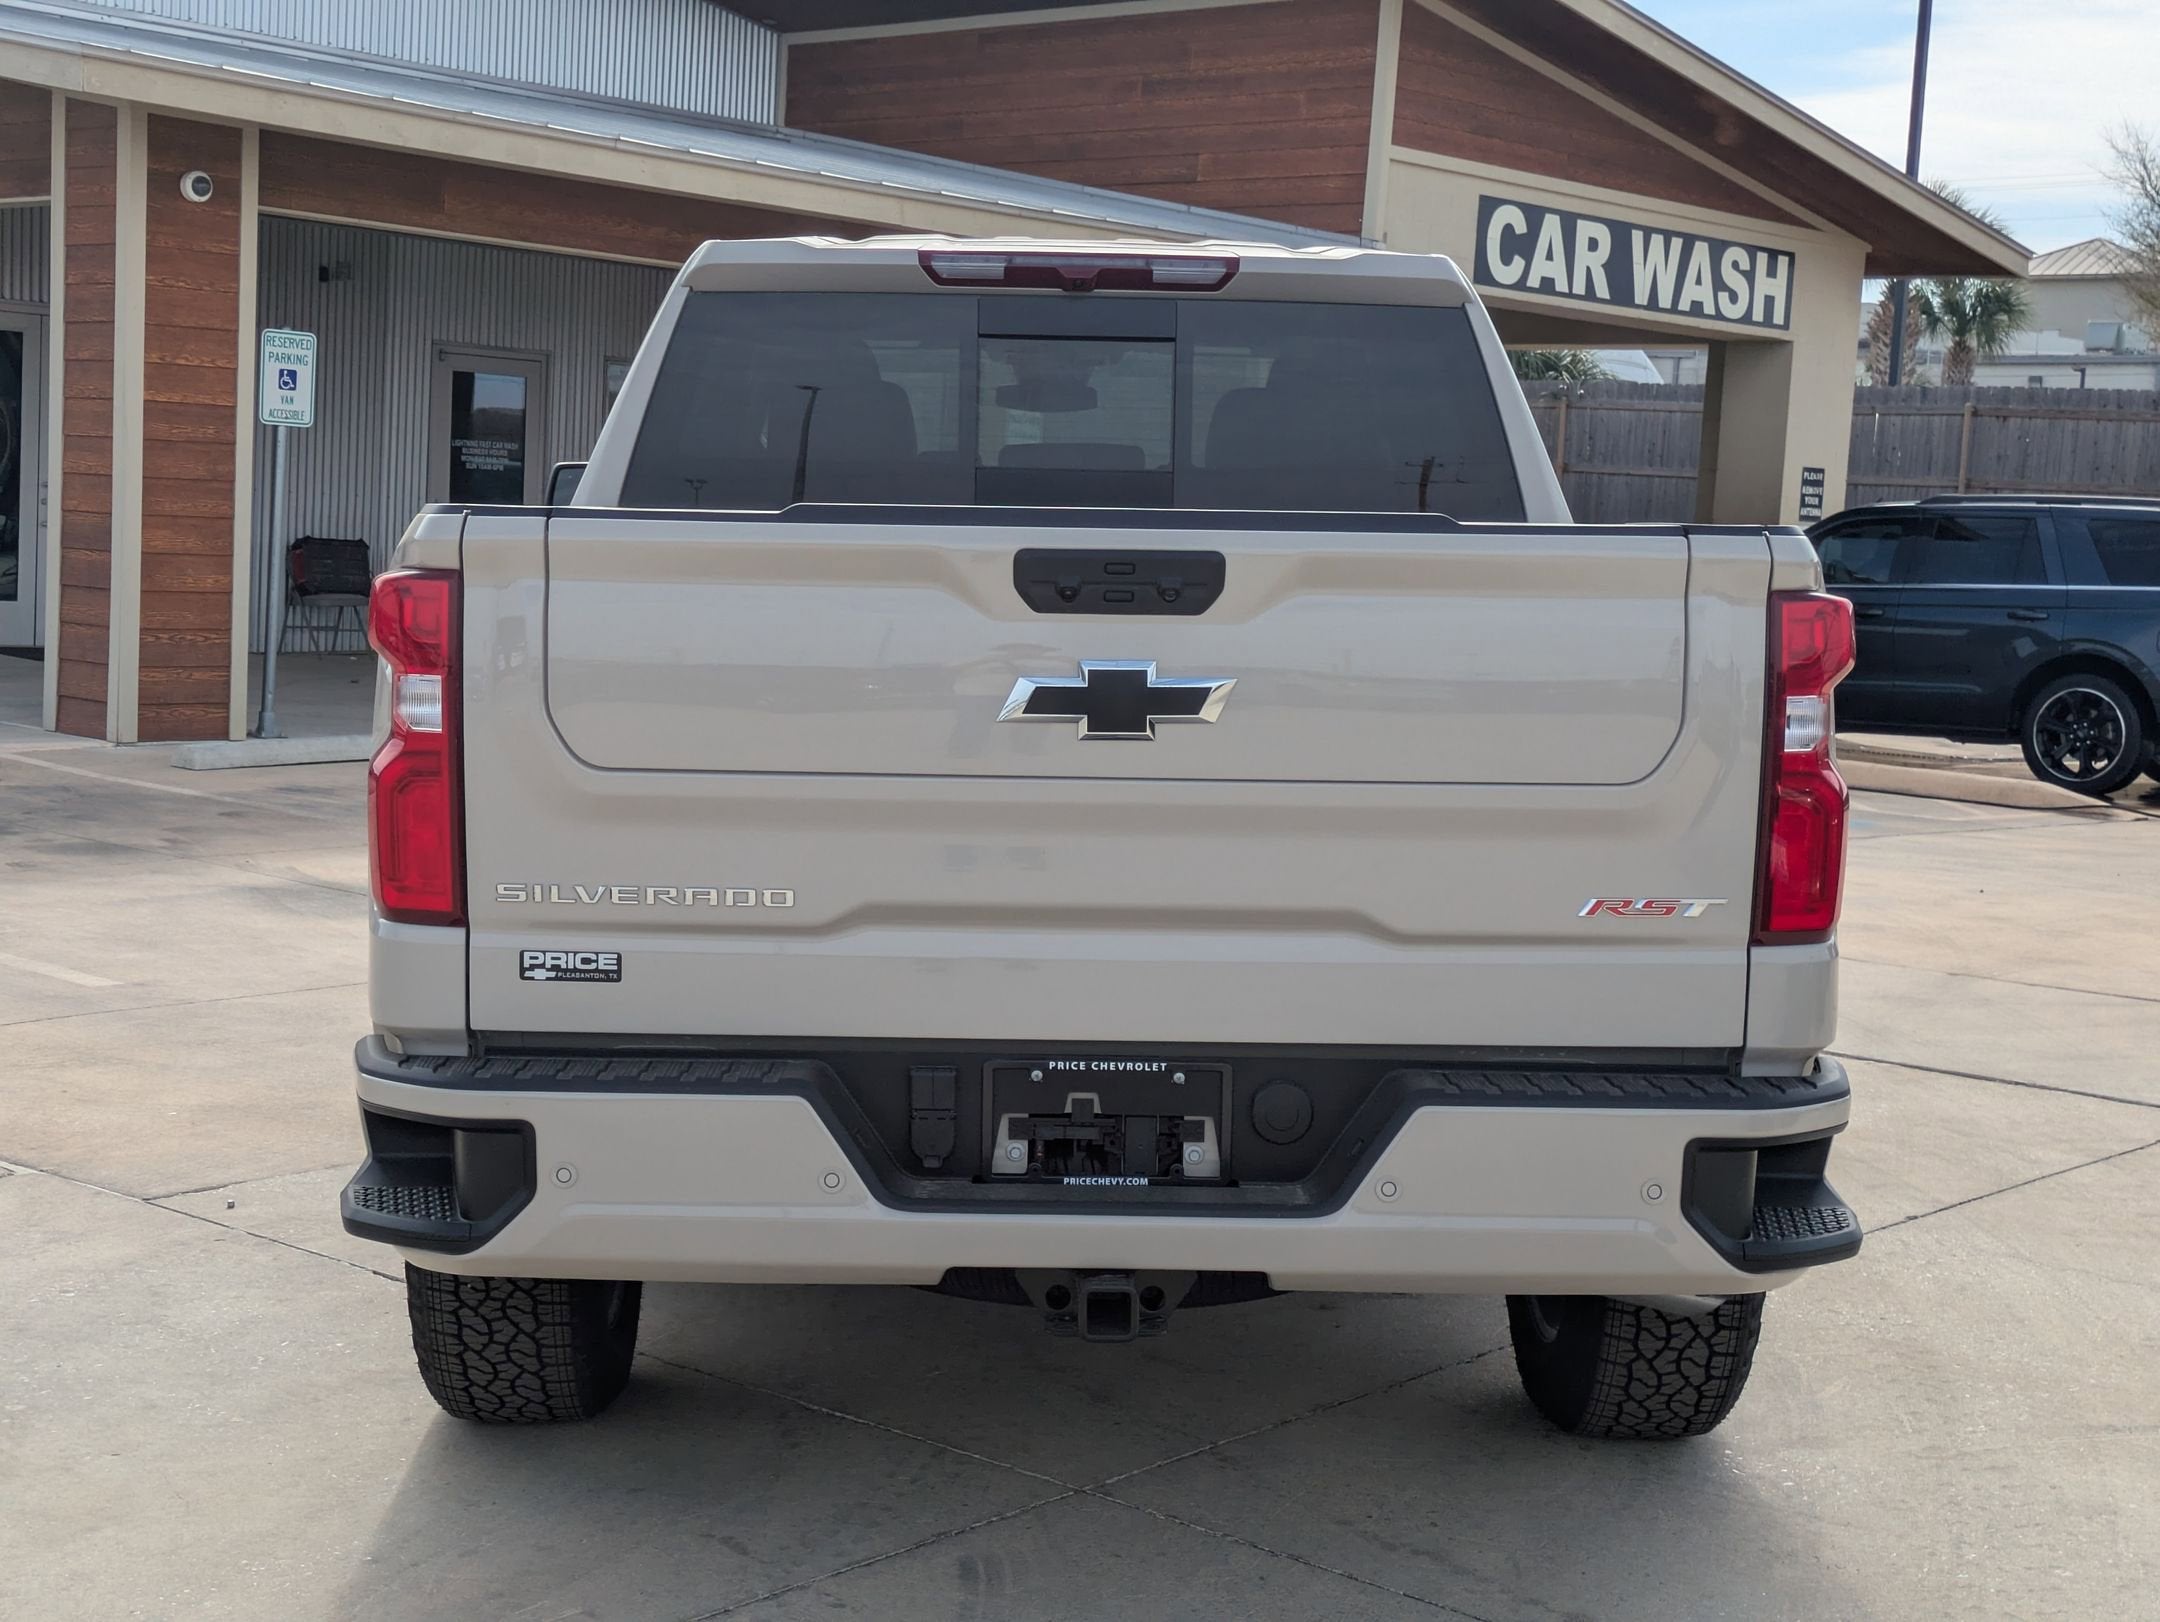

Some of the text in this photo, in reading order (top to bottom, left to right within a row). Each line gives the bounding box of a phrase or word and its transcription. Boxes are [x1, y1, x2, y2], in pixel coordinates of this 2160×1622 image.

[1486, 204, 1790, 326] CAR WASH
[265, 335, 312, 351] RESERVED
[268, 351, 309, 366] PARKING
[280, 395, 294, 405] VAN
[268, 408, 305, 421] ACCESSIBLE
[492, 441, 503, 449] CAR
[496, 883, 796, 908] SILVERADO
[1577, 898, 1729, 918] RST
[523, 951, 618, 970] PRICE
[557, 971, 607, 979] PLEASANTON,
[1049, 1061, 1168, 1072] PRICE CHEVROLET
[1063, 1177, 1149, 1186] PRICECHEVY.COM
